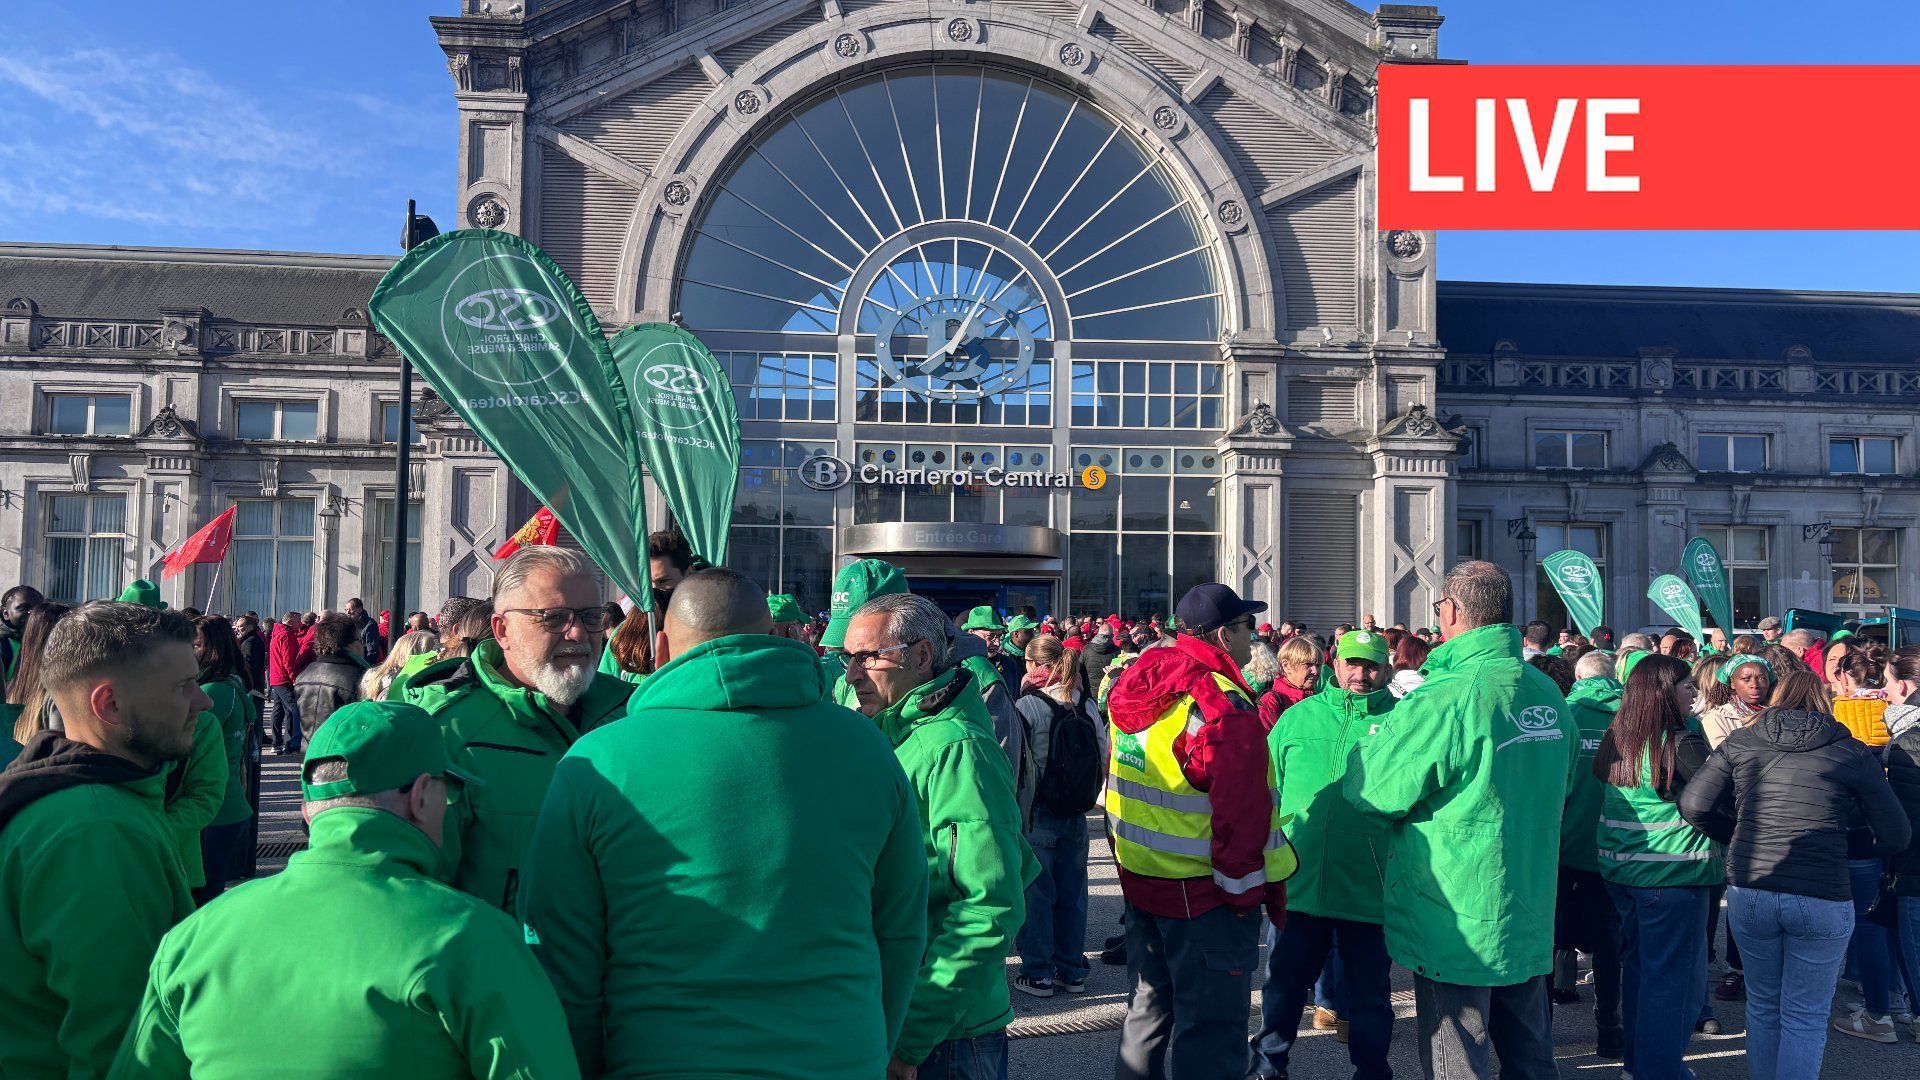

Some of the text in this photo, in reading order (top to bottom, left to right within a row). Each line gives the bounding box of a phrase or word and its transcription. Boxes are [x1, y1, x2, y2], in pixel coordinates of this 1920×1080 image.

[860, 463, 1074, 488] Charleroi-Central
[915, 530, 1001, 545] Entrée Gare
[1840, 585, 1876, 594] Paos
[1522, 707, 1555, 727] CSC
